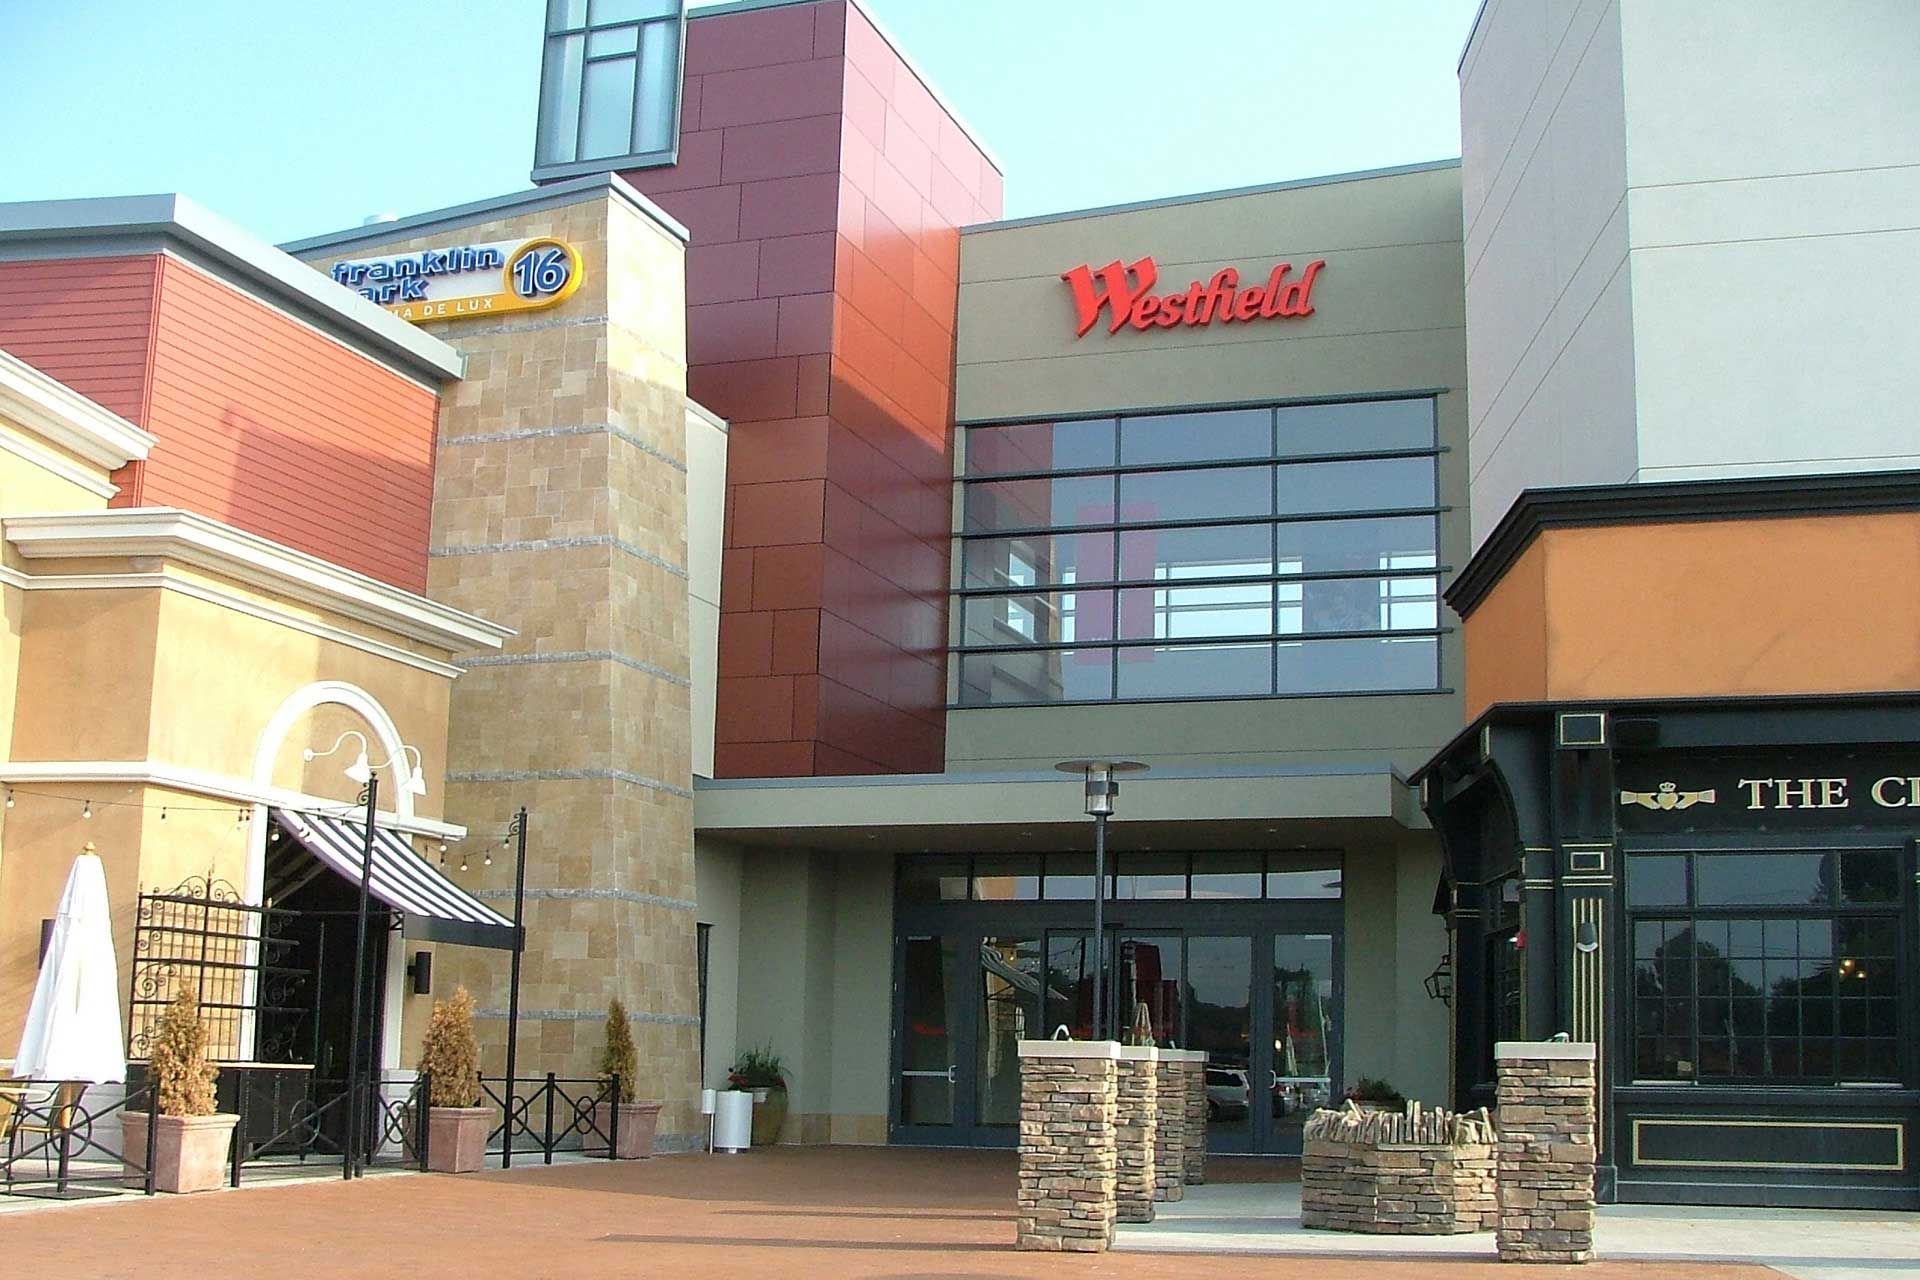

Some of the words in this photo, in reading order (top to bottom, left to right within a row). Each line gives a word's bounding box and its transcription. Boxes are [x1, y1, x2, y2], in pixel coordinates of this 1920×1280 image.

[331, 247, 504, 285] franklin
[513, 248, 567, 296] 16
[358, 276, 429, 303] ark
[423, 303, 446, 316] DE
[456, 298, 492, 313] LUX
[1060, 256, 1326, 338] Westfield
[1738, 777, 1849, 809] THE
